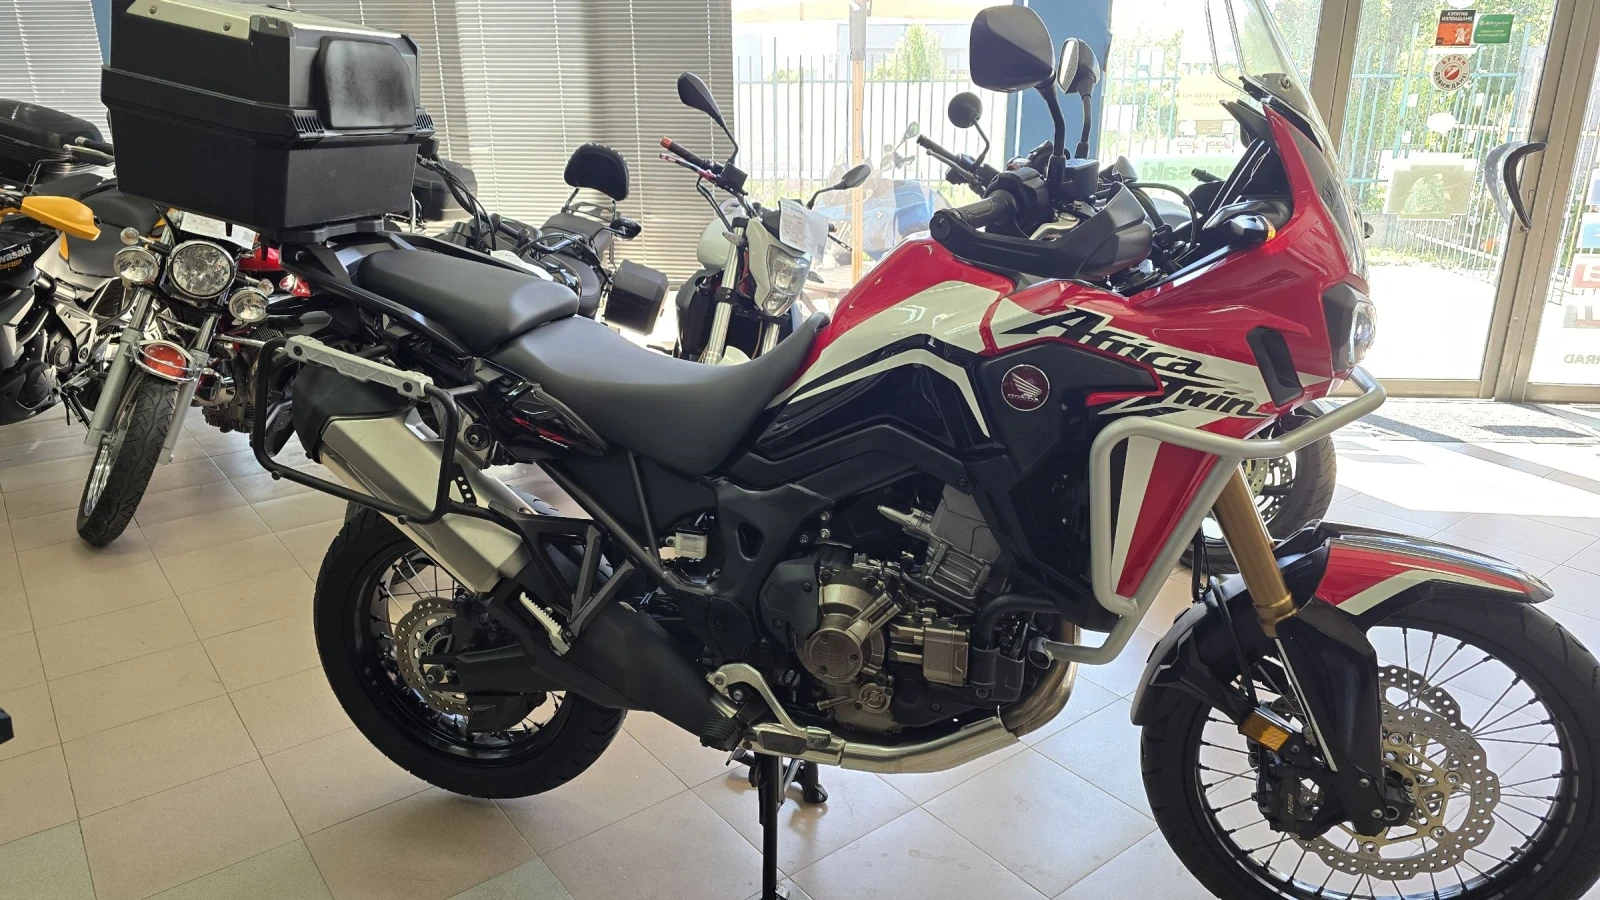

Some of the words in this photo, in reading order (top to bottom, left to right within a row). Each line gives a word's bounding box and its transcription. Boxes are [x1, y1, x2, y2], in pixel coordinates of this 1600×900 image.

[1442, 56, 1467, 65] БУТНИ
[0, 244, 32, 263] wasaki
[999, 307, 1230, 382] Africa
[1006, 393, 1041, 404] HONDA
[1120, 374, 1273, 418] Twin
